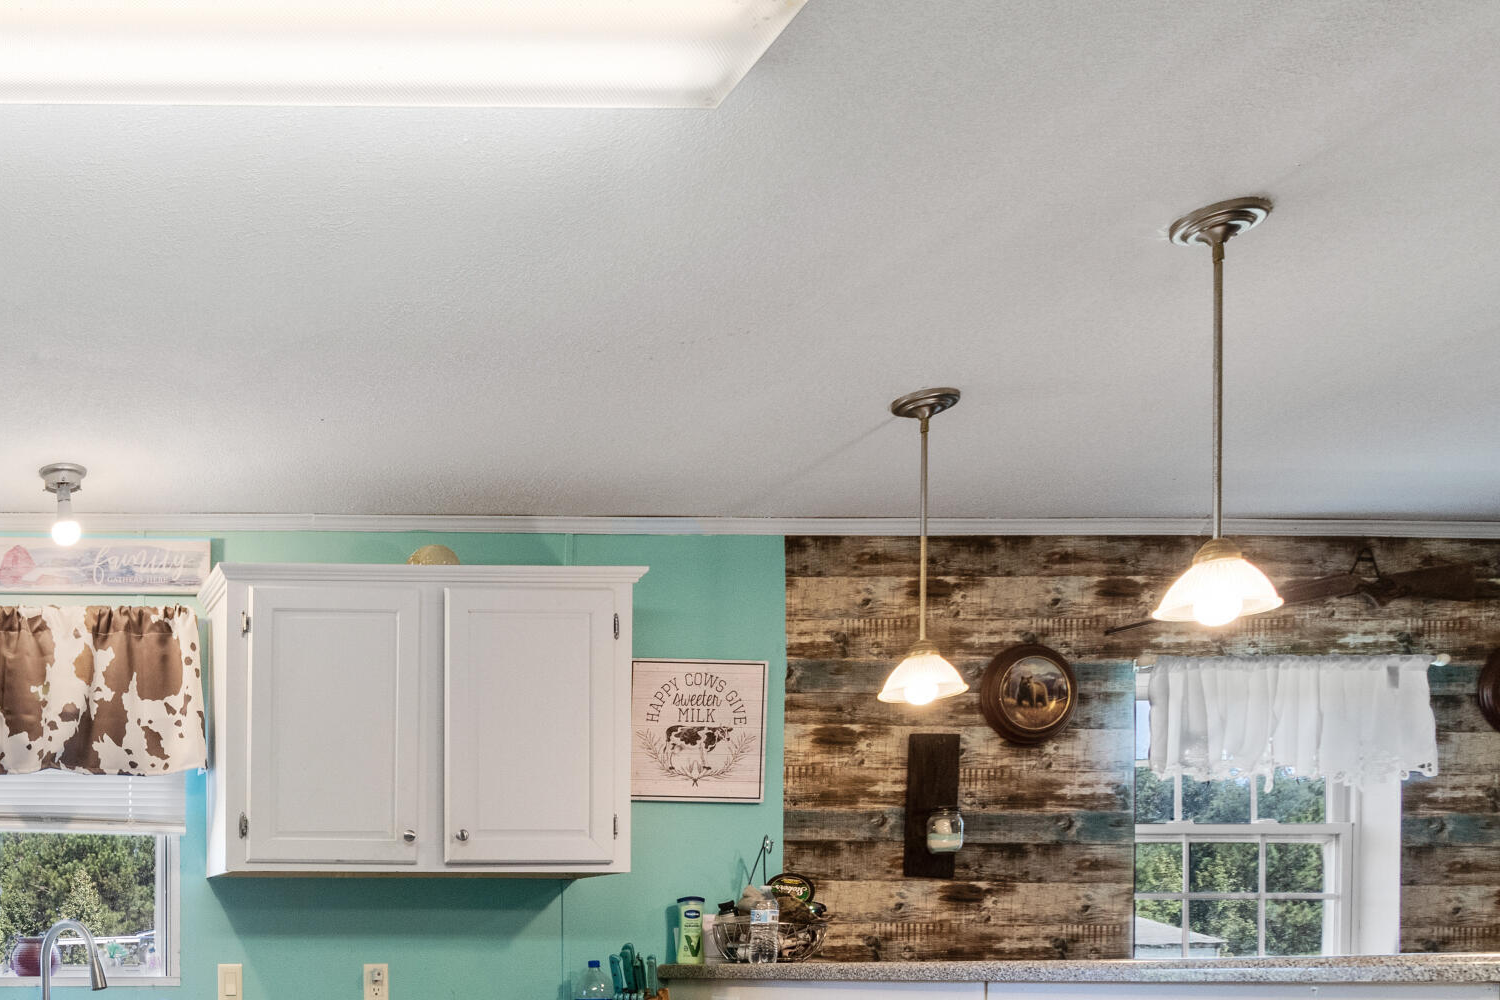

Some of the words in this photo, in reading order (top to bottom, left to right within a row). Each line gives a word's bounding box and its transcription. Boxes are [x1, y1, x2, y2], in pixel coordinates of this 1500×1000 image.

[83, 545, 186, 584] family
[646, 677, 681, 723] HAPPY
[684, 672, 727, 693] COWS
[725, 690, 747, 725] GIVE
[672, 690, 723, 707] sweeter
[678, 708, 716, 723] MILK
